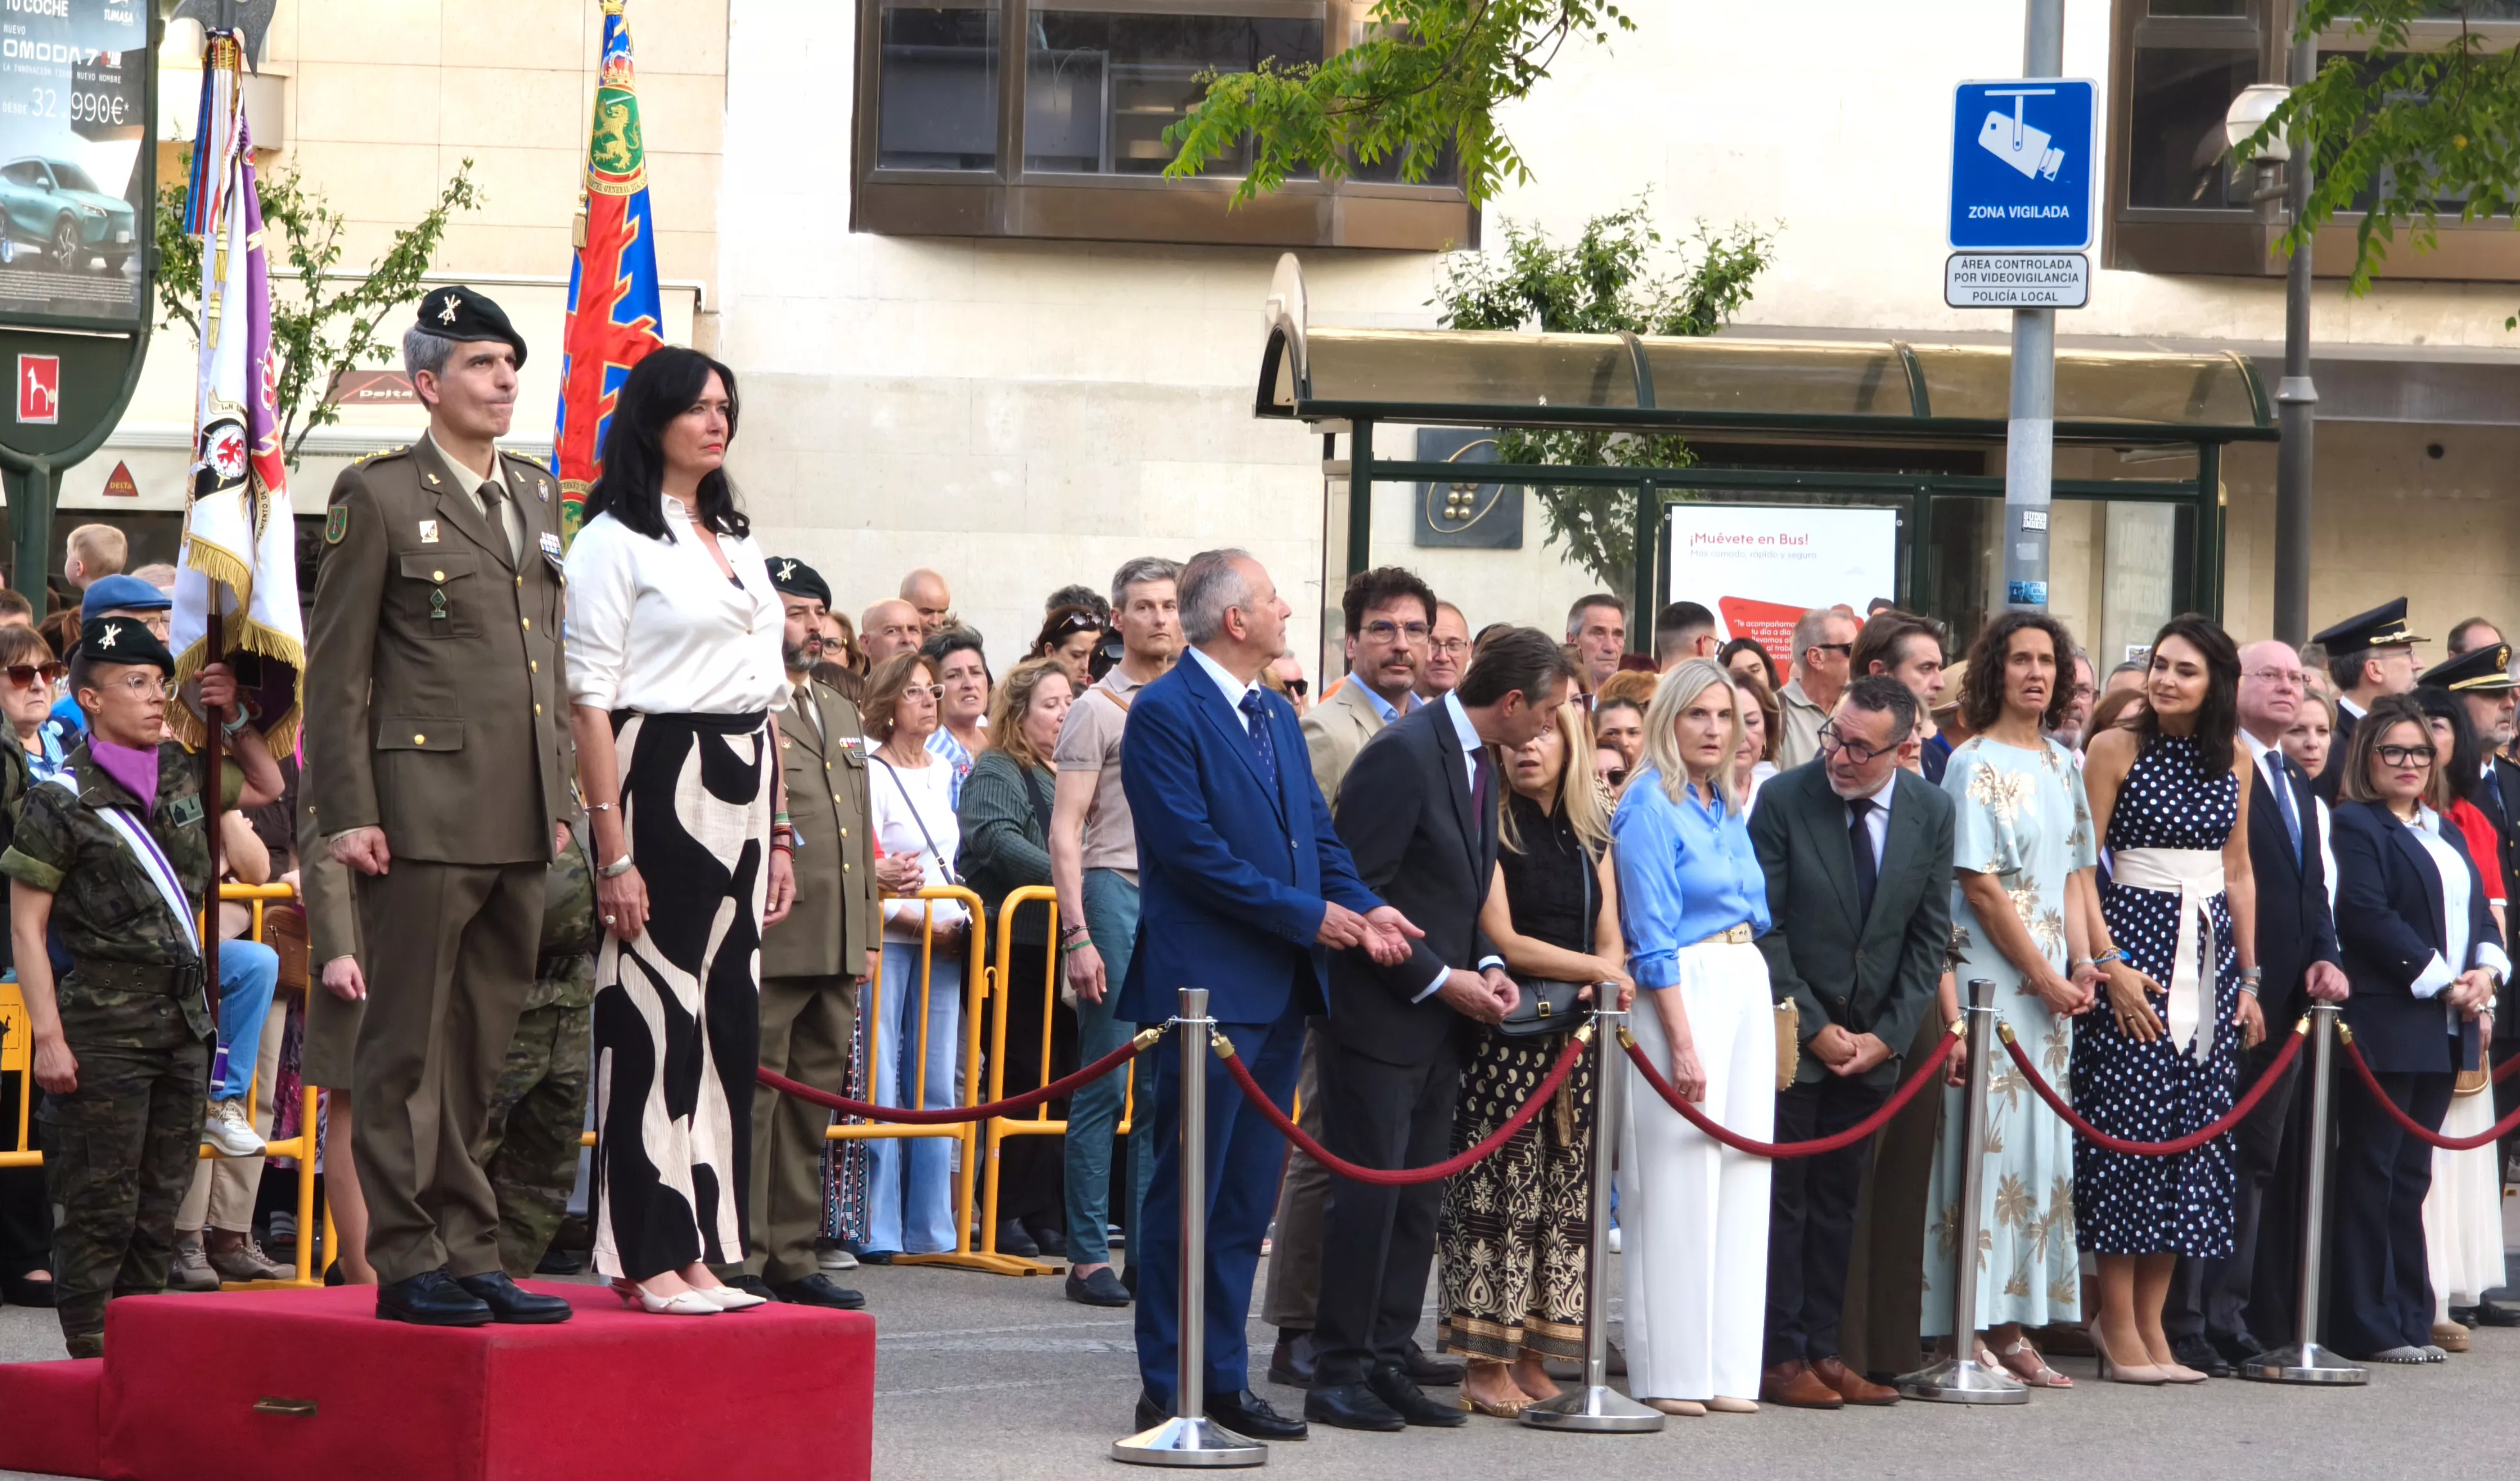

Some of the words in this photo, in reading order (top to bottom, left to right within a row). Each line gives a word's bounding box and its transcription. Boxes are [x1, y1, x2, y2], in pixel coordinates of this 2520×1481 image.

[24, 0, 69, 17] COCHE
[104, 9, 134, 23] TUMASA
[4, 24, 26, 35] NUEVO
[3, 39, 82, 65] OMODA
[84, 48, 98, 66] 7
[3, 63, 10, 72] LA
[76, 71, 96, 82] NUEVO
[99, 73, 122, 84] NOMBRE
[3, 101, 28, 115] DESDE
[604, 185, 630, 193] GENERAL
[1968, 206, 2005, 219] ZONA
[2009, 206, 2069, 218] VIGILADA
[1961, 257, 1991, 269] ÁREA
[1995, 260, 2073, 269] CONTROLADA
[1954, 273, 1977, 283] POR
[1981, 273, 2079, 283] VIDEOVIGILANCIA
[1972, 289, 2017, 301] POLICÍA
[2021, 292, 2058, 301] LOCAL
[110, 481, 132, 490] DELTA
[259, 490, 267, 501] DE
[1690, 532, 1754, 547] ¡Muévete
[1758, 535, 1775, 545] en
[1779, 534, 1808, 545] Bus!
[1691, 550, 1708, 558] Más
[1750, 550, 1778, 560] rápido
[1787, 552, 1817, 561] seguro
[1746, 620, 1796, 629] acompañamo
[1760, 627, 1771, 636] día
